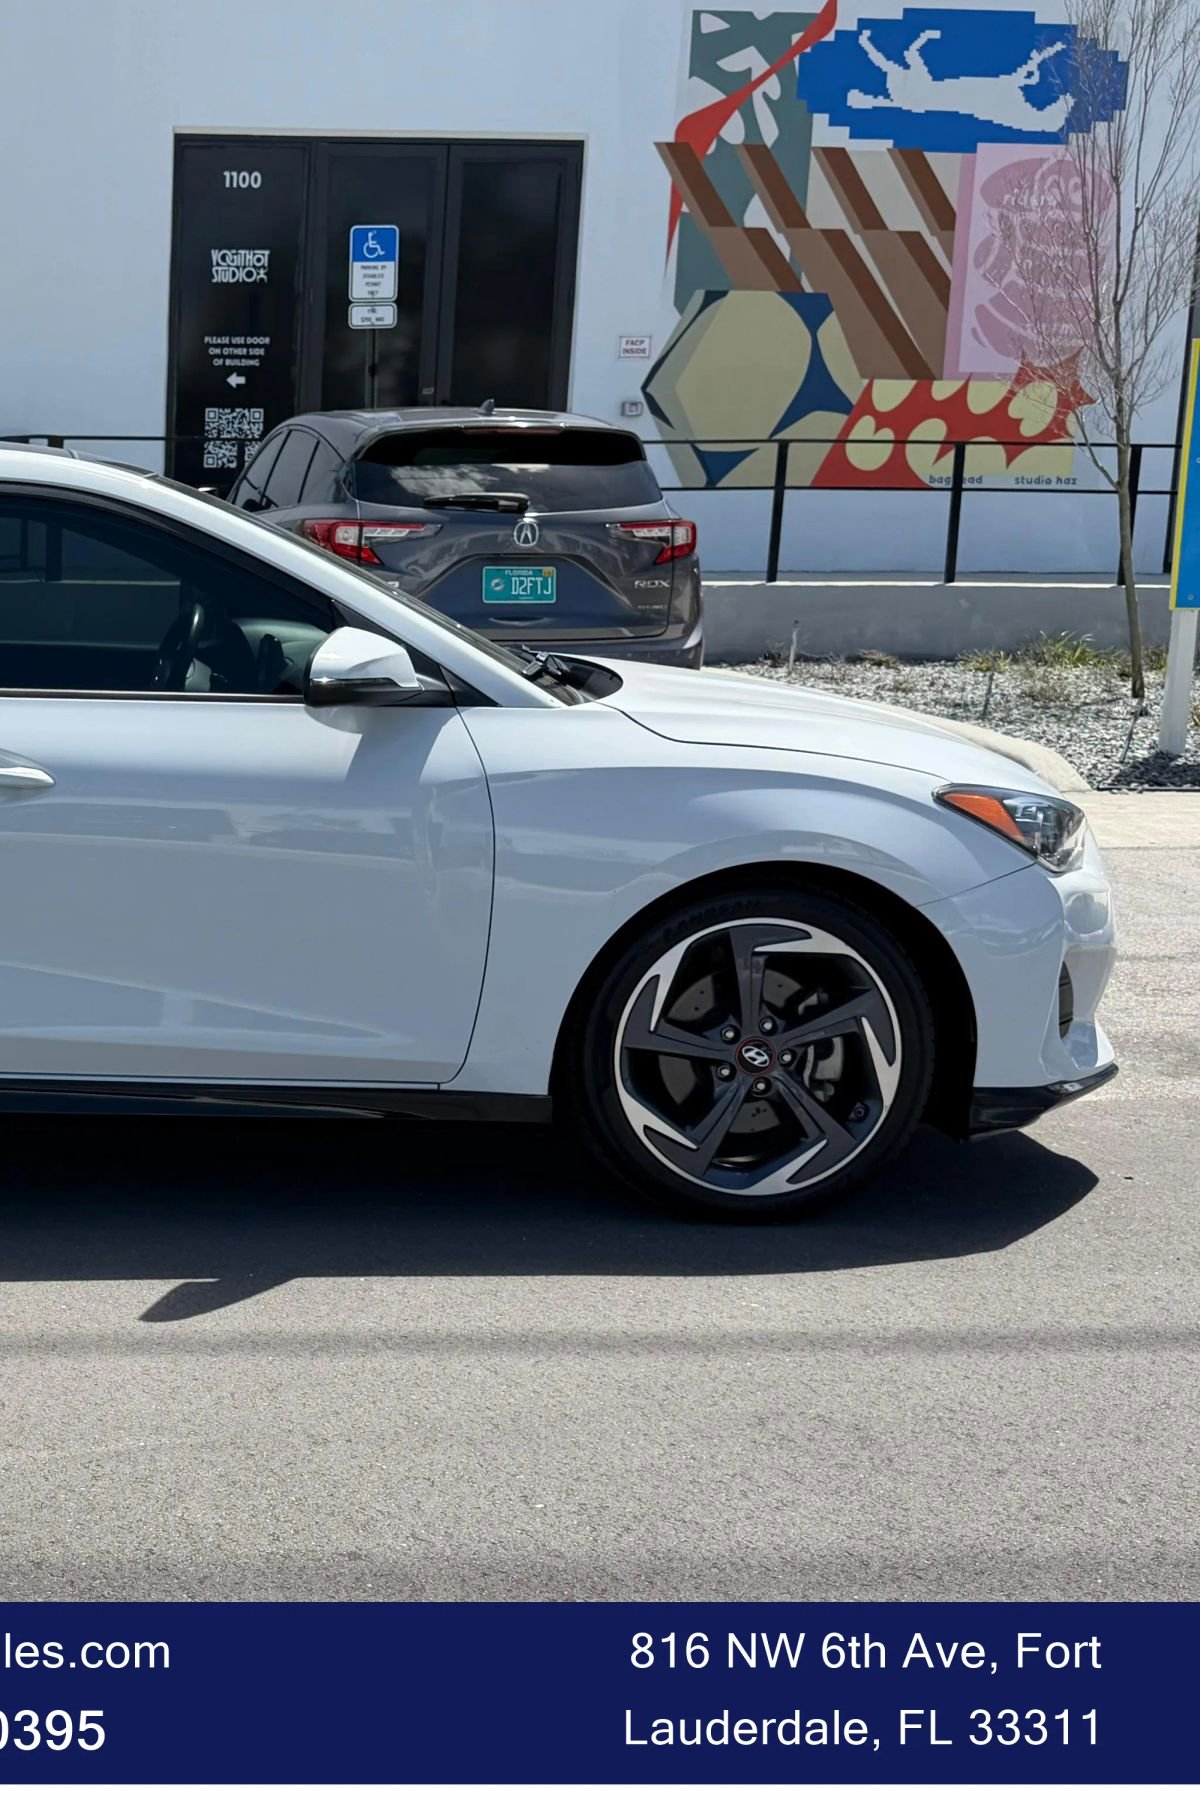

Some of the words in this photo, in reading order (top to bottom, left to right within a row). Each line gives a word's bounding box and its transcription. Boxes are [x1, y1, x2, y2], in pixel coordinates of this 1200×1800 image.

[223, 171, 262, 188] 1100
[212, 266, 257, 283] STUDIO
[204, 336, 229, 344] PLEASE
[231, 336, 245, 344] USE
[246, 336, 270, 344] DOOR
[208, 347, 221, 355] ON
[222, 347, 247, 355] OTHER
[249, 347, 265, 355] SIDE
[212, 358, 223, 366] OF
[225, 358, 260, 366] BUILDING
[928, 475, 983, 486] bagead
[1014, 475, 1052, 485] studio
[1055, 475, 1078, 485] haz
[634, 580, 670, 589] RDX
